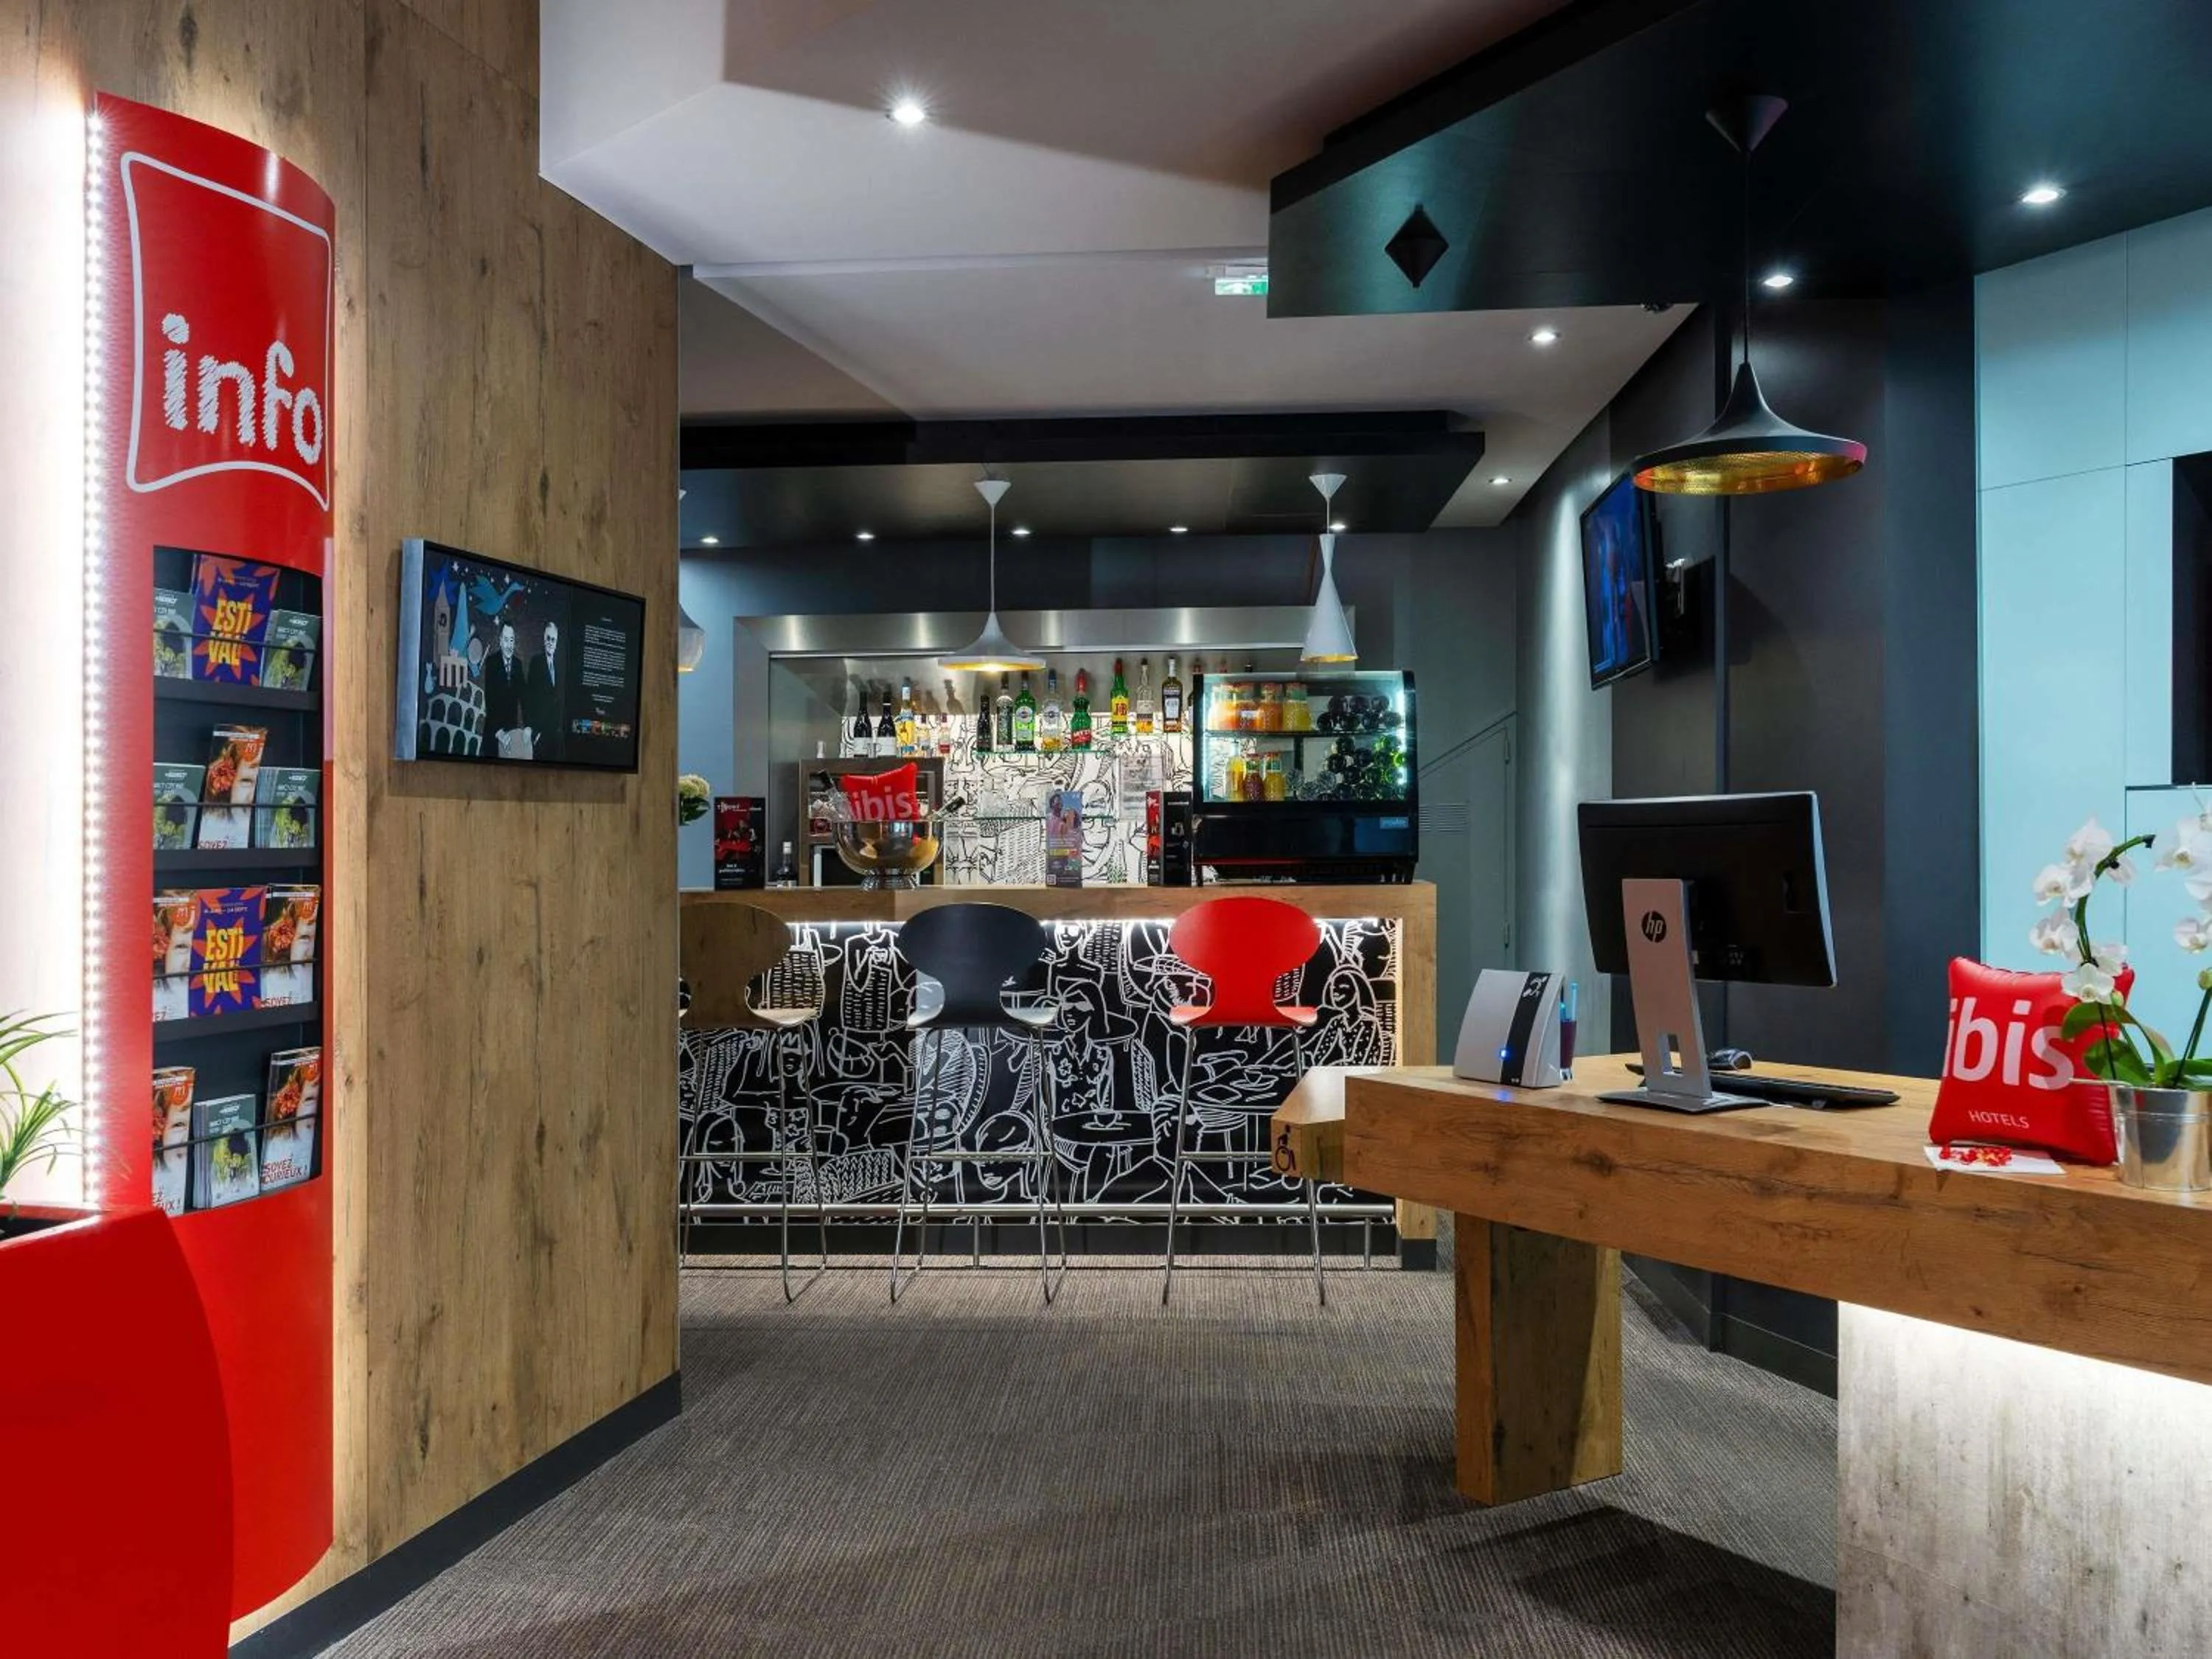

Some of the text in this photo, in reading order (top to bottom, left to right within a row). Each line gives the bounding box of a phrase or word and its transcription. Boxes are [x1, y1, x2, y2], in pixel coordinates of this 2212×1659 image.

[161, 313, 323, 465] info
[852, 786, 913, 821] ibis
[1645, 911, 1663, 942] hp
[1968, 1109, 2029, 1129] HOTELS
